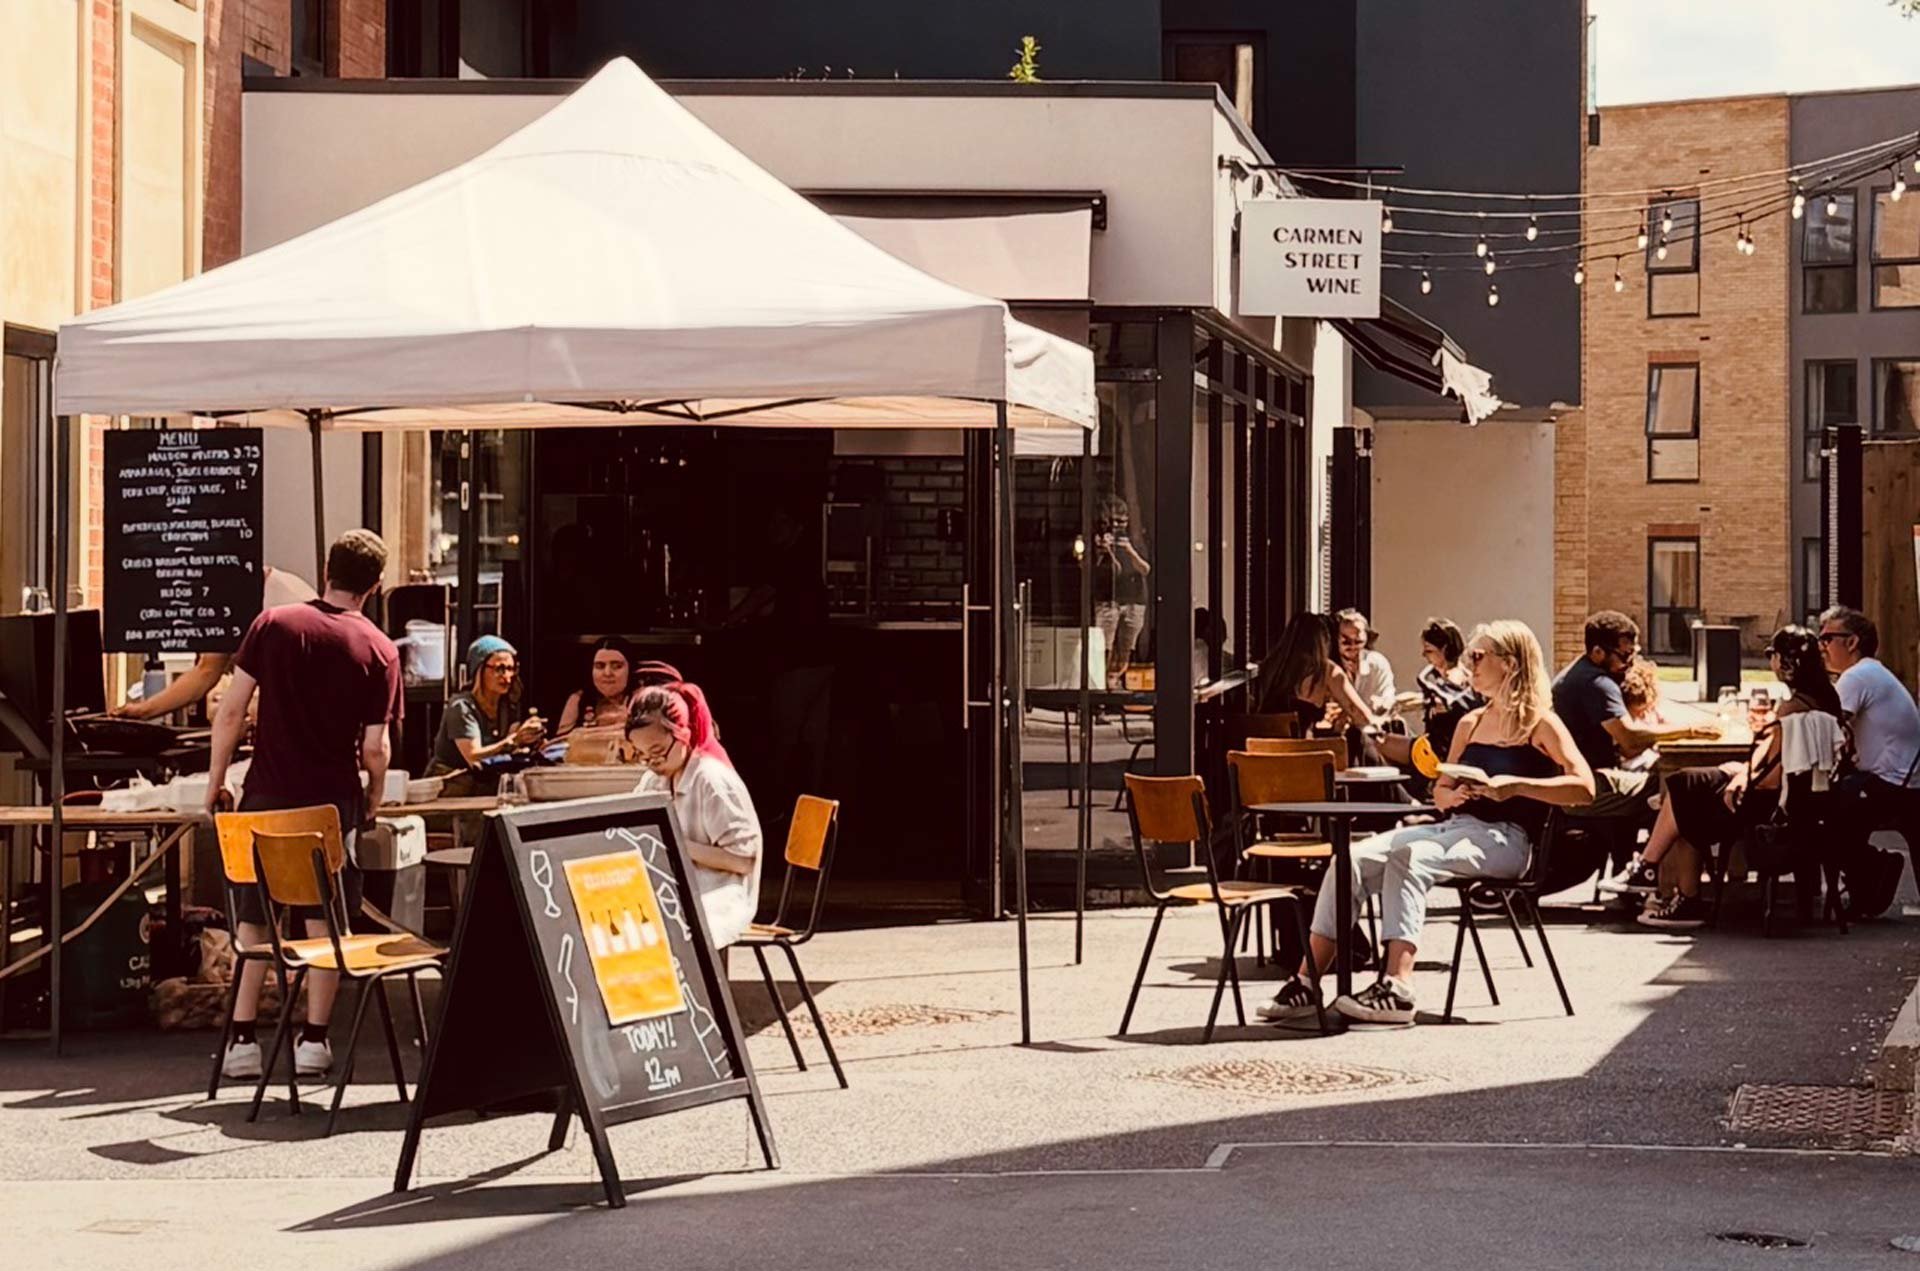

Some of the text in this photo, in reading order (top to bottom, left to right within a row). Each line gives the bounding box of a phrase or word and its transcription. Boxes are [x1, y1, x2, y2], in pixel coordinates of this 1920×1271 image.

[1272, 227, 1363, 245] CARMEN
[1284, 252, 1362, 270] STREET
[1305, 277, 1362, 295] WINE
[159, 432, 199, 446] MENU
[247, 463, 259, 477] 7
[235, 479, 248, 491] 12
[239, 529, 253, 539] 10
[202, 586, 210, 598] 7
[621, 1016, 677, 1054] TODAY!
